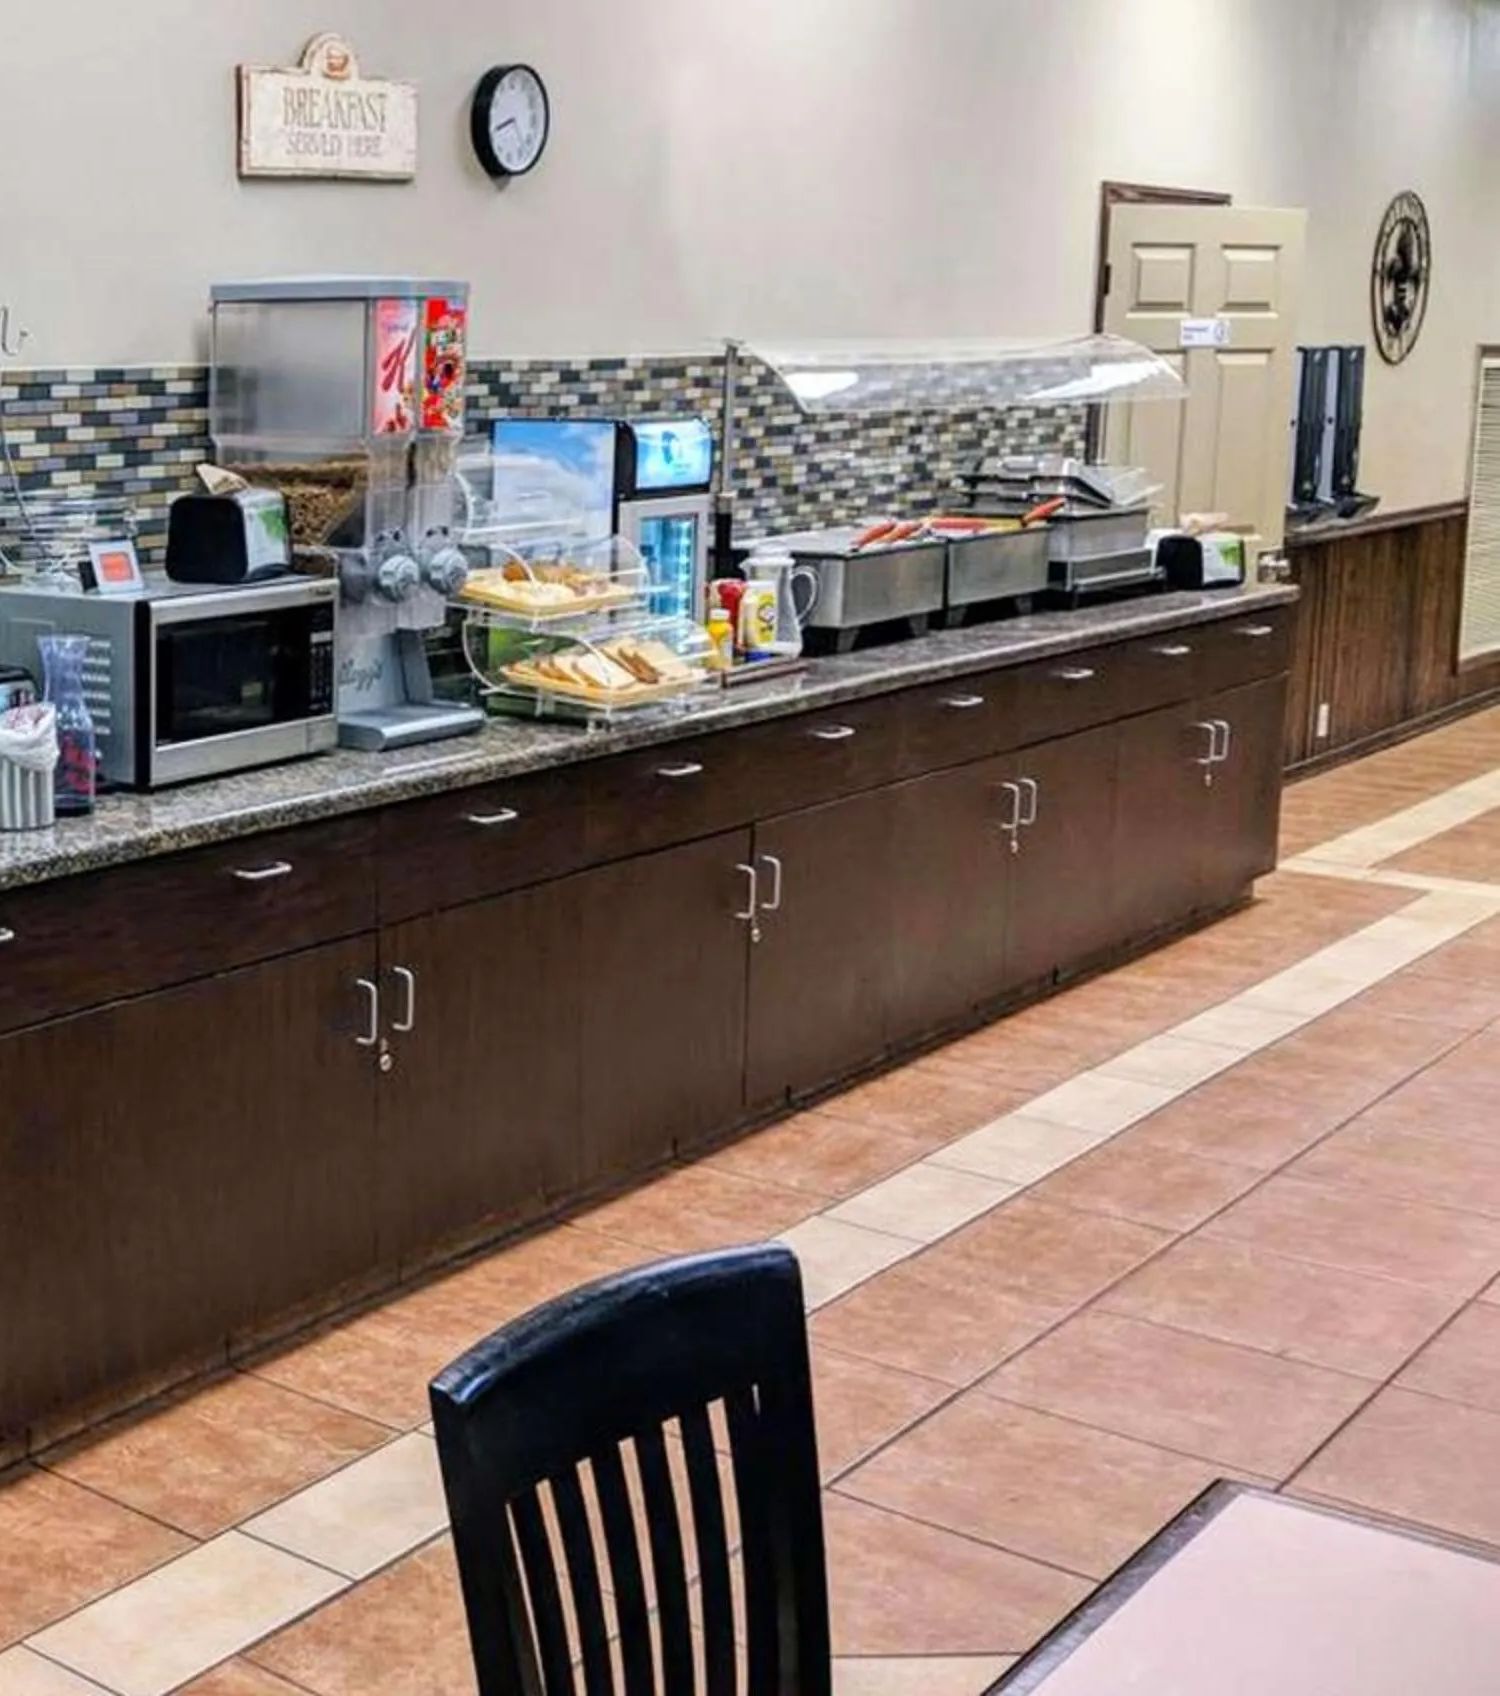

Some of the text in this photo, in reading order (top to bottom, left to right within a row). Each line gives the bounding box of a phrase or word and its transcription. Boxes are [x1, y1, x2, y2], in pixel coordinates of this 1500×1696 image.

[282, 86, 388, 132] BREAKFAST
[285, 131, 382, 158] SERVED HERE
